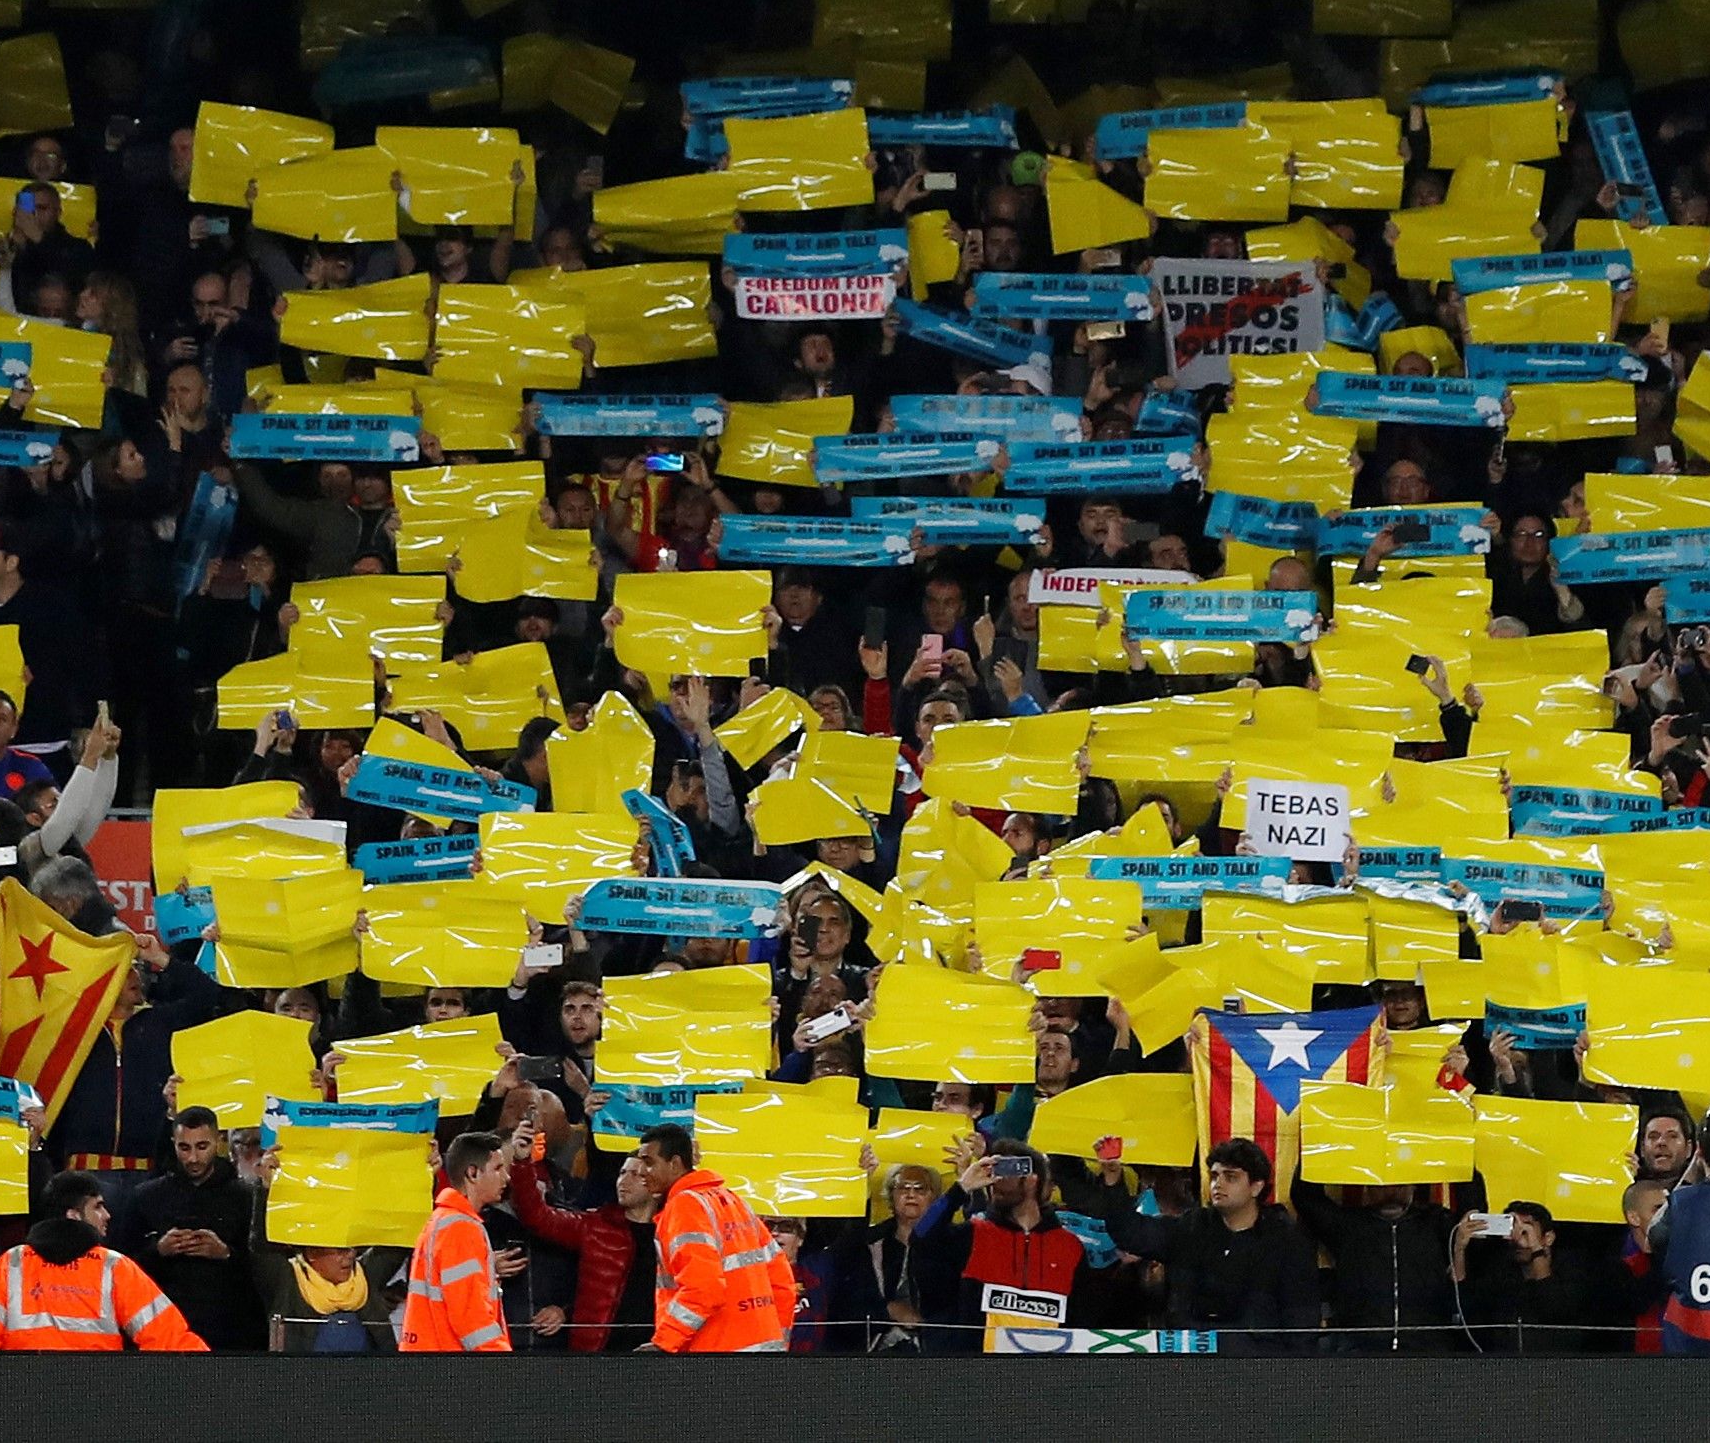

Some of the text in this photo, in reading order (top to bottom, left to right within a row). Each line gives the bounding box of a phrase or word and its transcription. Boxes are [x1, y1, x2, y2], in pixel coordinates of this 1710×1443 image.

[796, 237, 813, 249] SIT
[818, 237, 841, 248] AND
[306, 419, 323, 430] SIT
[329, 419, 351, 430] AND
[1079, 446, 1097, 458] SIT
[1103, 446, 1126, 457] AND
[431, 772, 448, 784] SIT
[1257, 792, 1339, 817] TEBAS
[1677, 812, 1695, 824] SIT
[1268, 824, 1325, 846] NAZI
[424, 842, 442, 854] SIT
[449, 839, 475, 850] AND
[1170, 863, 1188, 876] SIT
[1194, 863, 1219, 875] AND
[1225, 863, 1259, 875] TALK!
[991, 1292, 1058, 1316] ellesse
